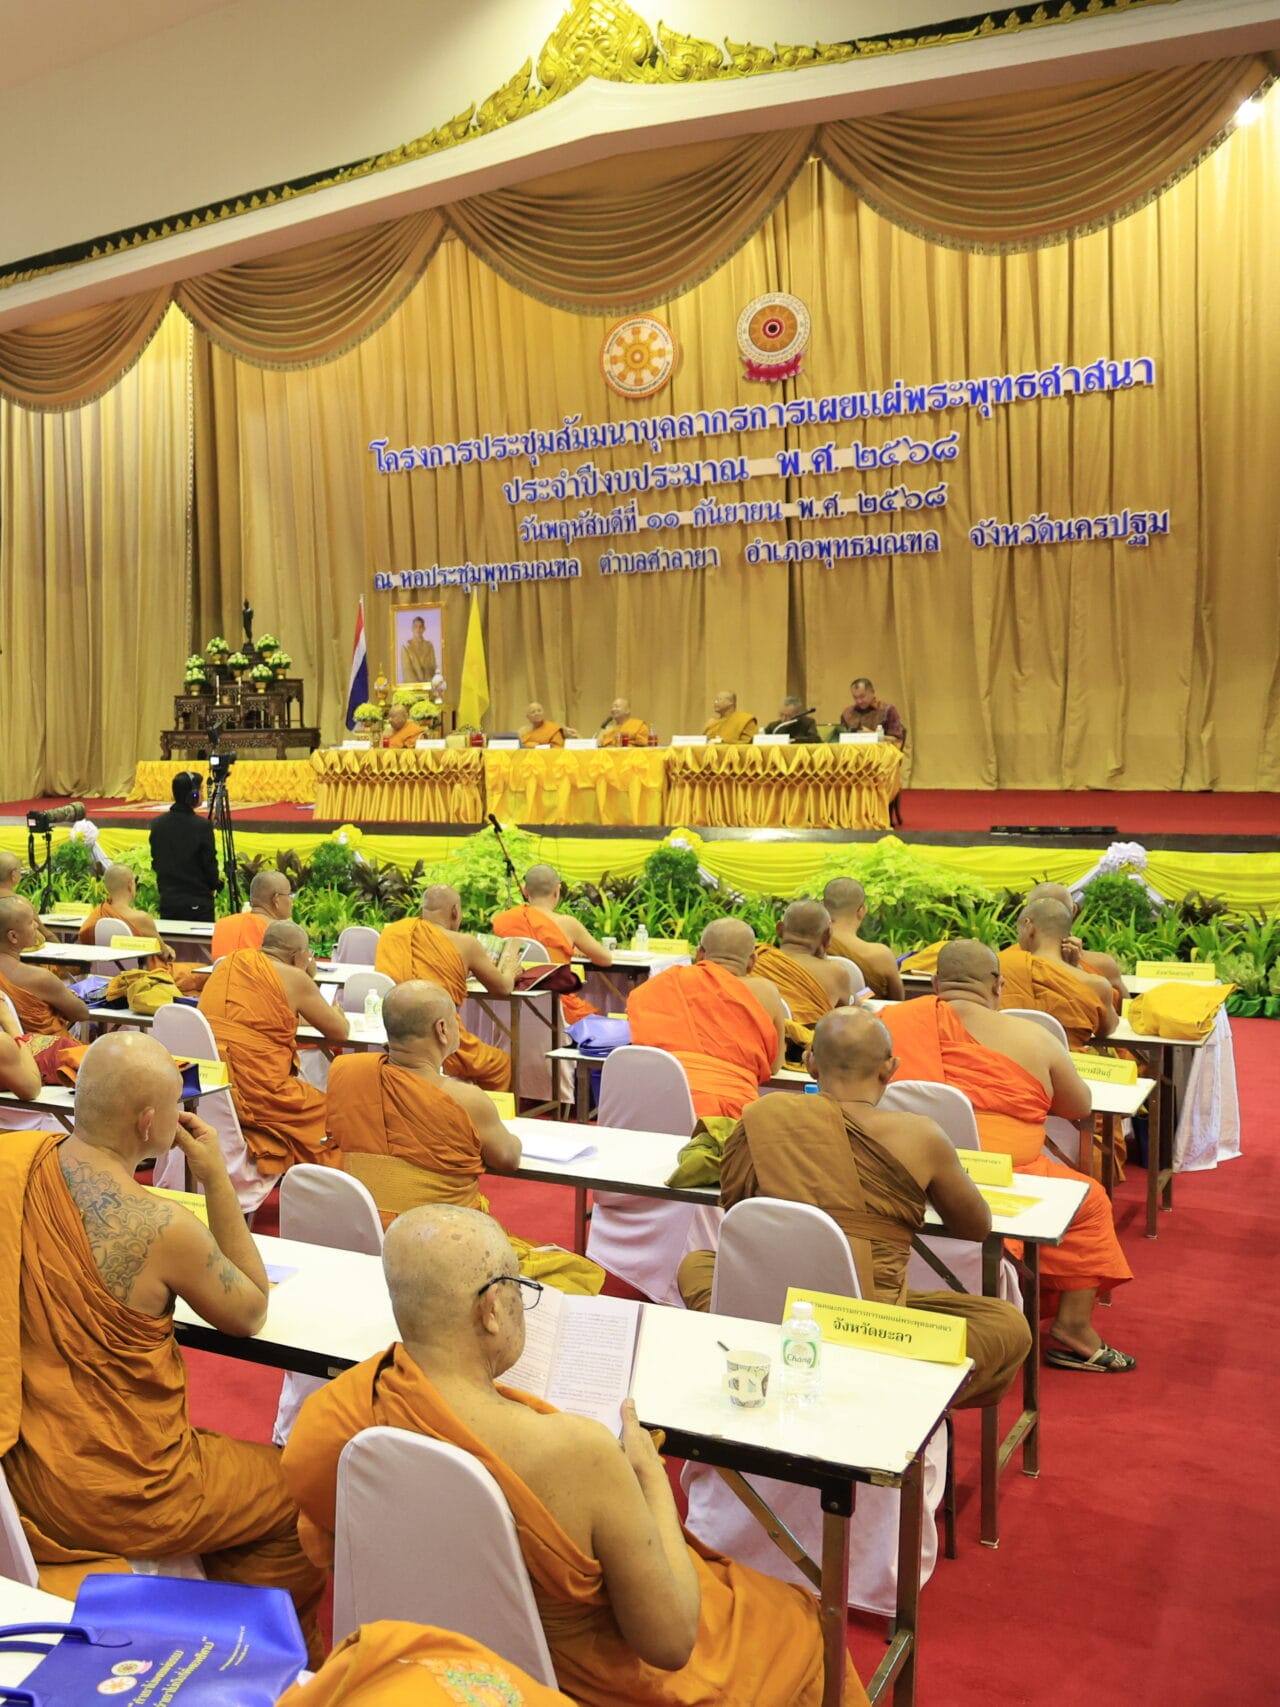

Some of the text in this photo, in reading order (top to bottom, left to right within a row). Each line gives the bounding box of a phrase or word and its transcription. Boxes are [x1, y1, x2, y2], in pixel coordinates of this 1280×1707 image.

[370, 357, 1155, 473] โครงการประชุมสัมมนาบุคลากรการเผยแผ่พระพุทธศาสนา
[504, 457, 749, 503] ประจำปีงบประมาณ
[853, 433, 959, 470] ๒๕๖๘
[520, 499, 638, 543] วันพฤหัสบดีที่
[646, 512, 680, 530] ๑๑
[693, 497, 783, 528] กันยายน
[858, 485, 947, 515] ๒๕๖๘
[374, 509, 1170, 592] ณ หอประชุมพุทธมณฑล ตำบลศาลายา อำเภอพุทธมณฑล จังหวัดนครปฐม
[832, 1317, 913, 1344] จังหวัดยะลา
